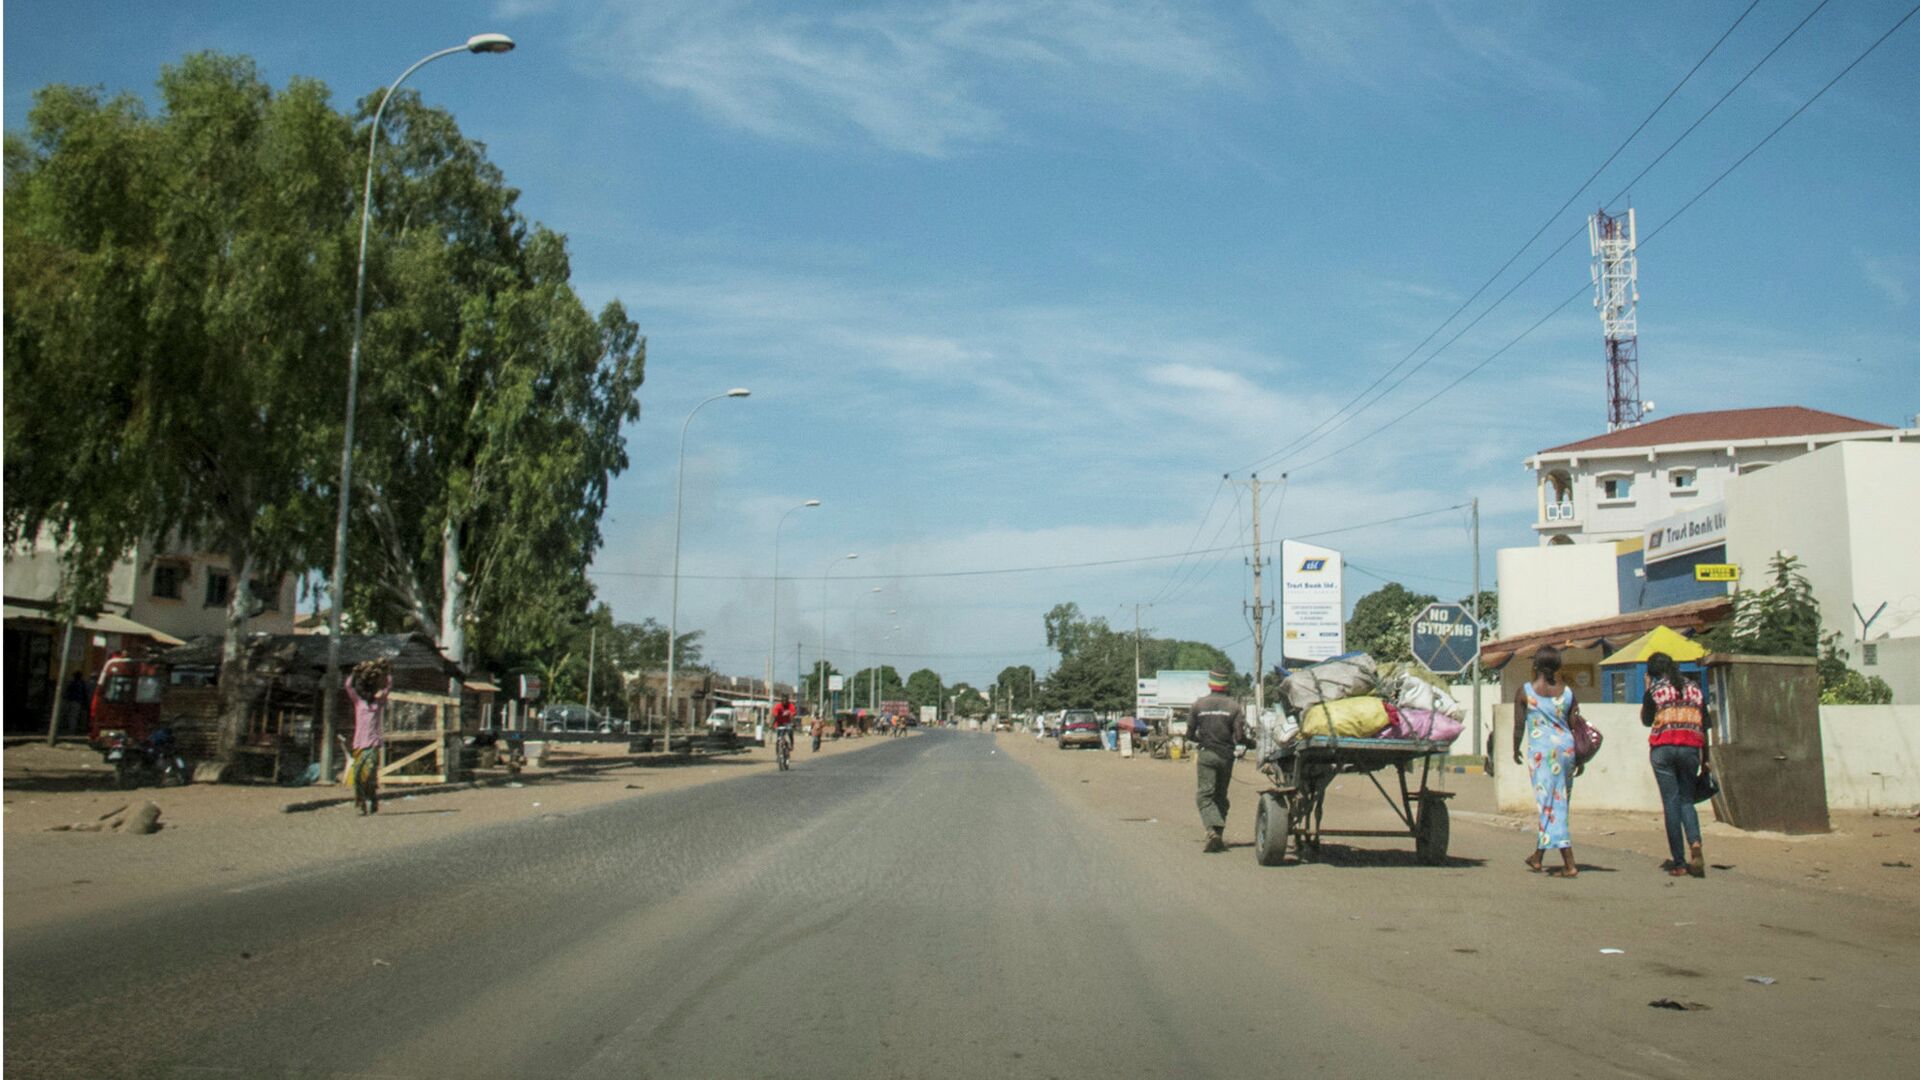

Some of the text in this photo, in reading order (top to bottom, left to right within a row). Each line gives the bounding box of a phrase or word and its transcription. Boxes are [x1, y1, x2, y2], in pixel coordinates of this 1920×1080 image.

[1666, 523, 1687, 543] Trust
[1689, 516, 1713, 537] Bank
[1430, 608, 1449, 622] NO
